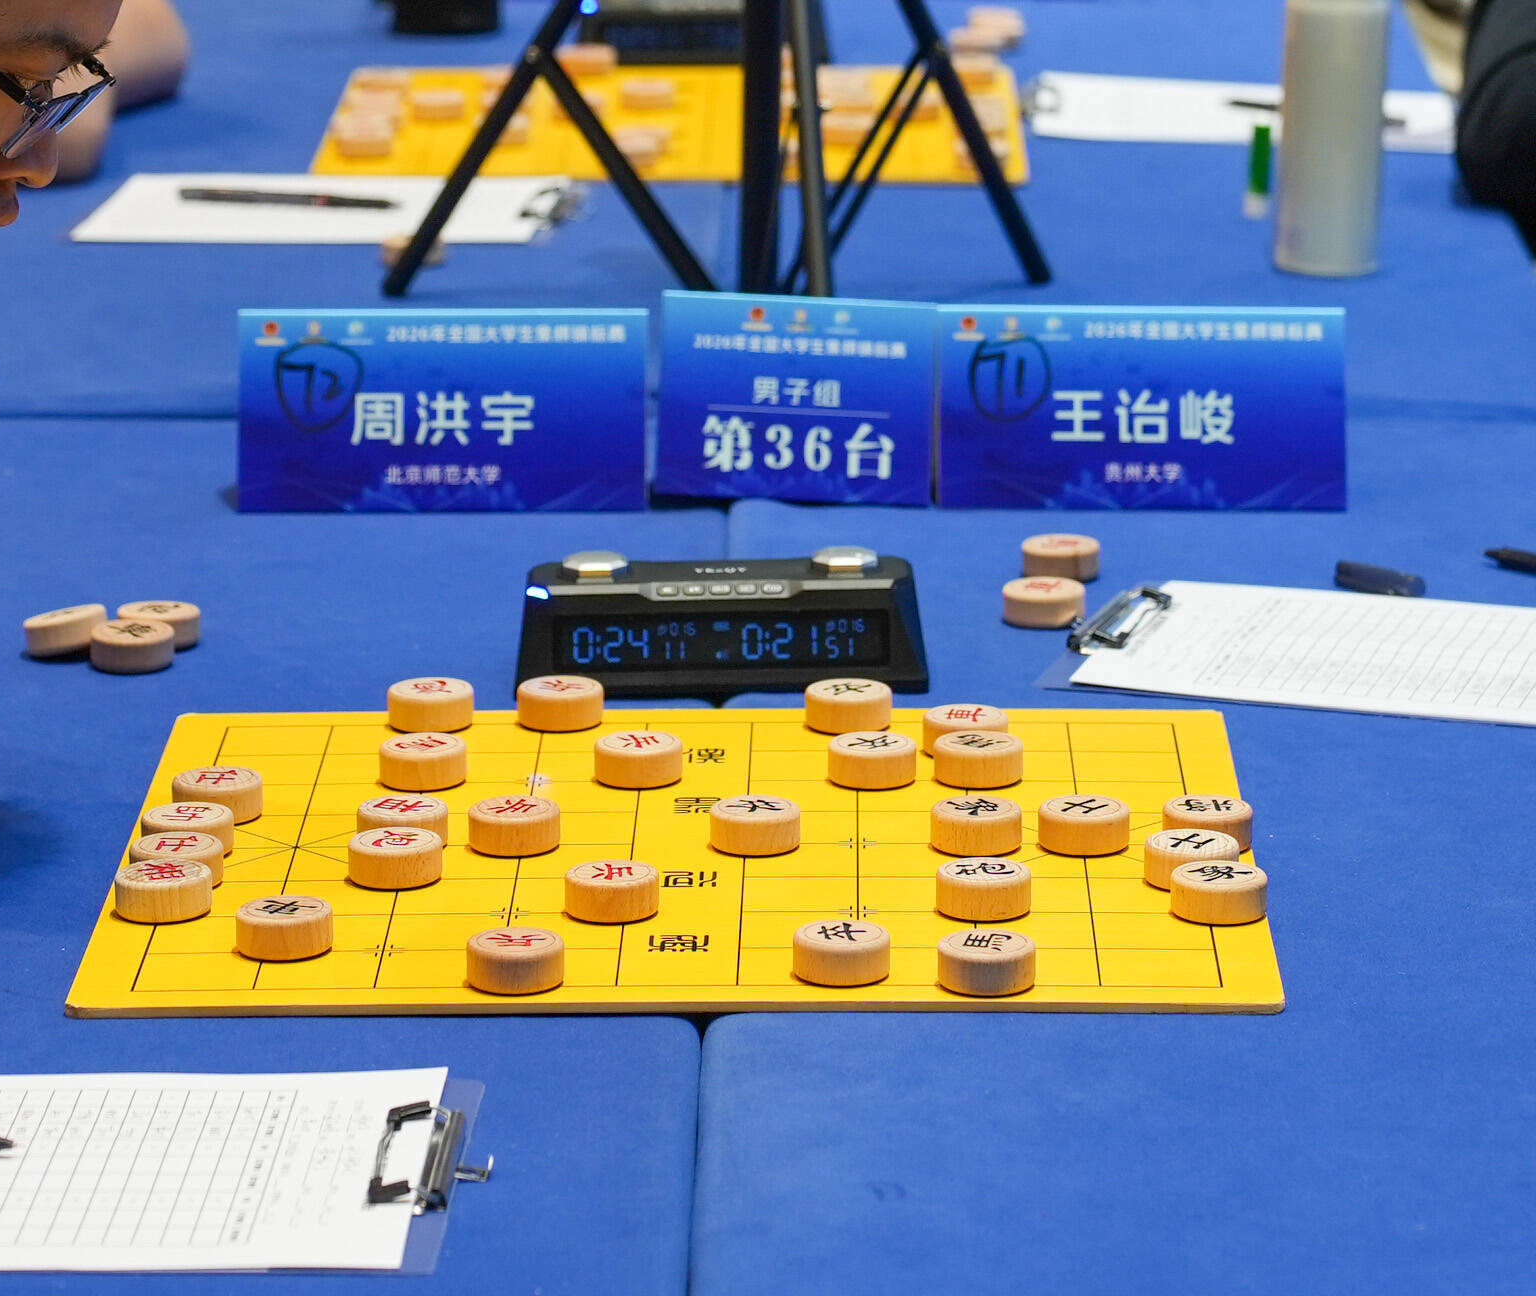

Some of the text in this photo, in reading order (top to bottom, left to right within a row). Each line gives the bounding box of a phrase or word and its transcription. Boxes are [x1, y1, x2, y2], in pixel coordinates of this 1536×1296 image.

[751, 375, 842, 408] 男子组
[350, 391, 536, 446] 周洪宇
[702, 414, 896, 480] 第36台
[384, 464, 502, 486] 北京师范大学
[946, 707, 987, 723] 車
[620, 733, 660, 749] 兵
[195, 769, 237, 786] 仕
[375, 798, 426, 813] 相
[488, 799, 538, 814] 兵
[1060, 798, 1109, 816] 士
[155, 835, 199, 854] 仕
[376, 830, 419, 848] 炮
[1170, 833, 1216, 851] 士
[138, 863, 186, 881] 相
[591, 863, 633, 881] 兵
[1190, 865, 1254, 882] 象
[817, 922, 866, 943] 卒
[963, 933, 1013, 952] 馬
